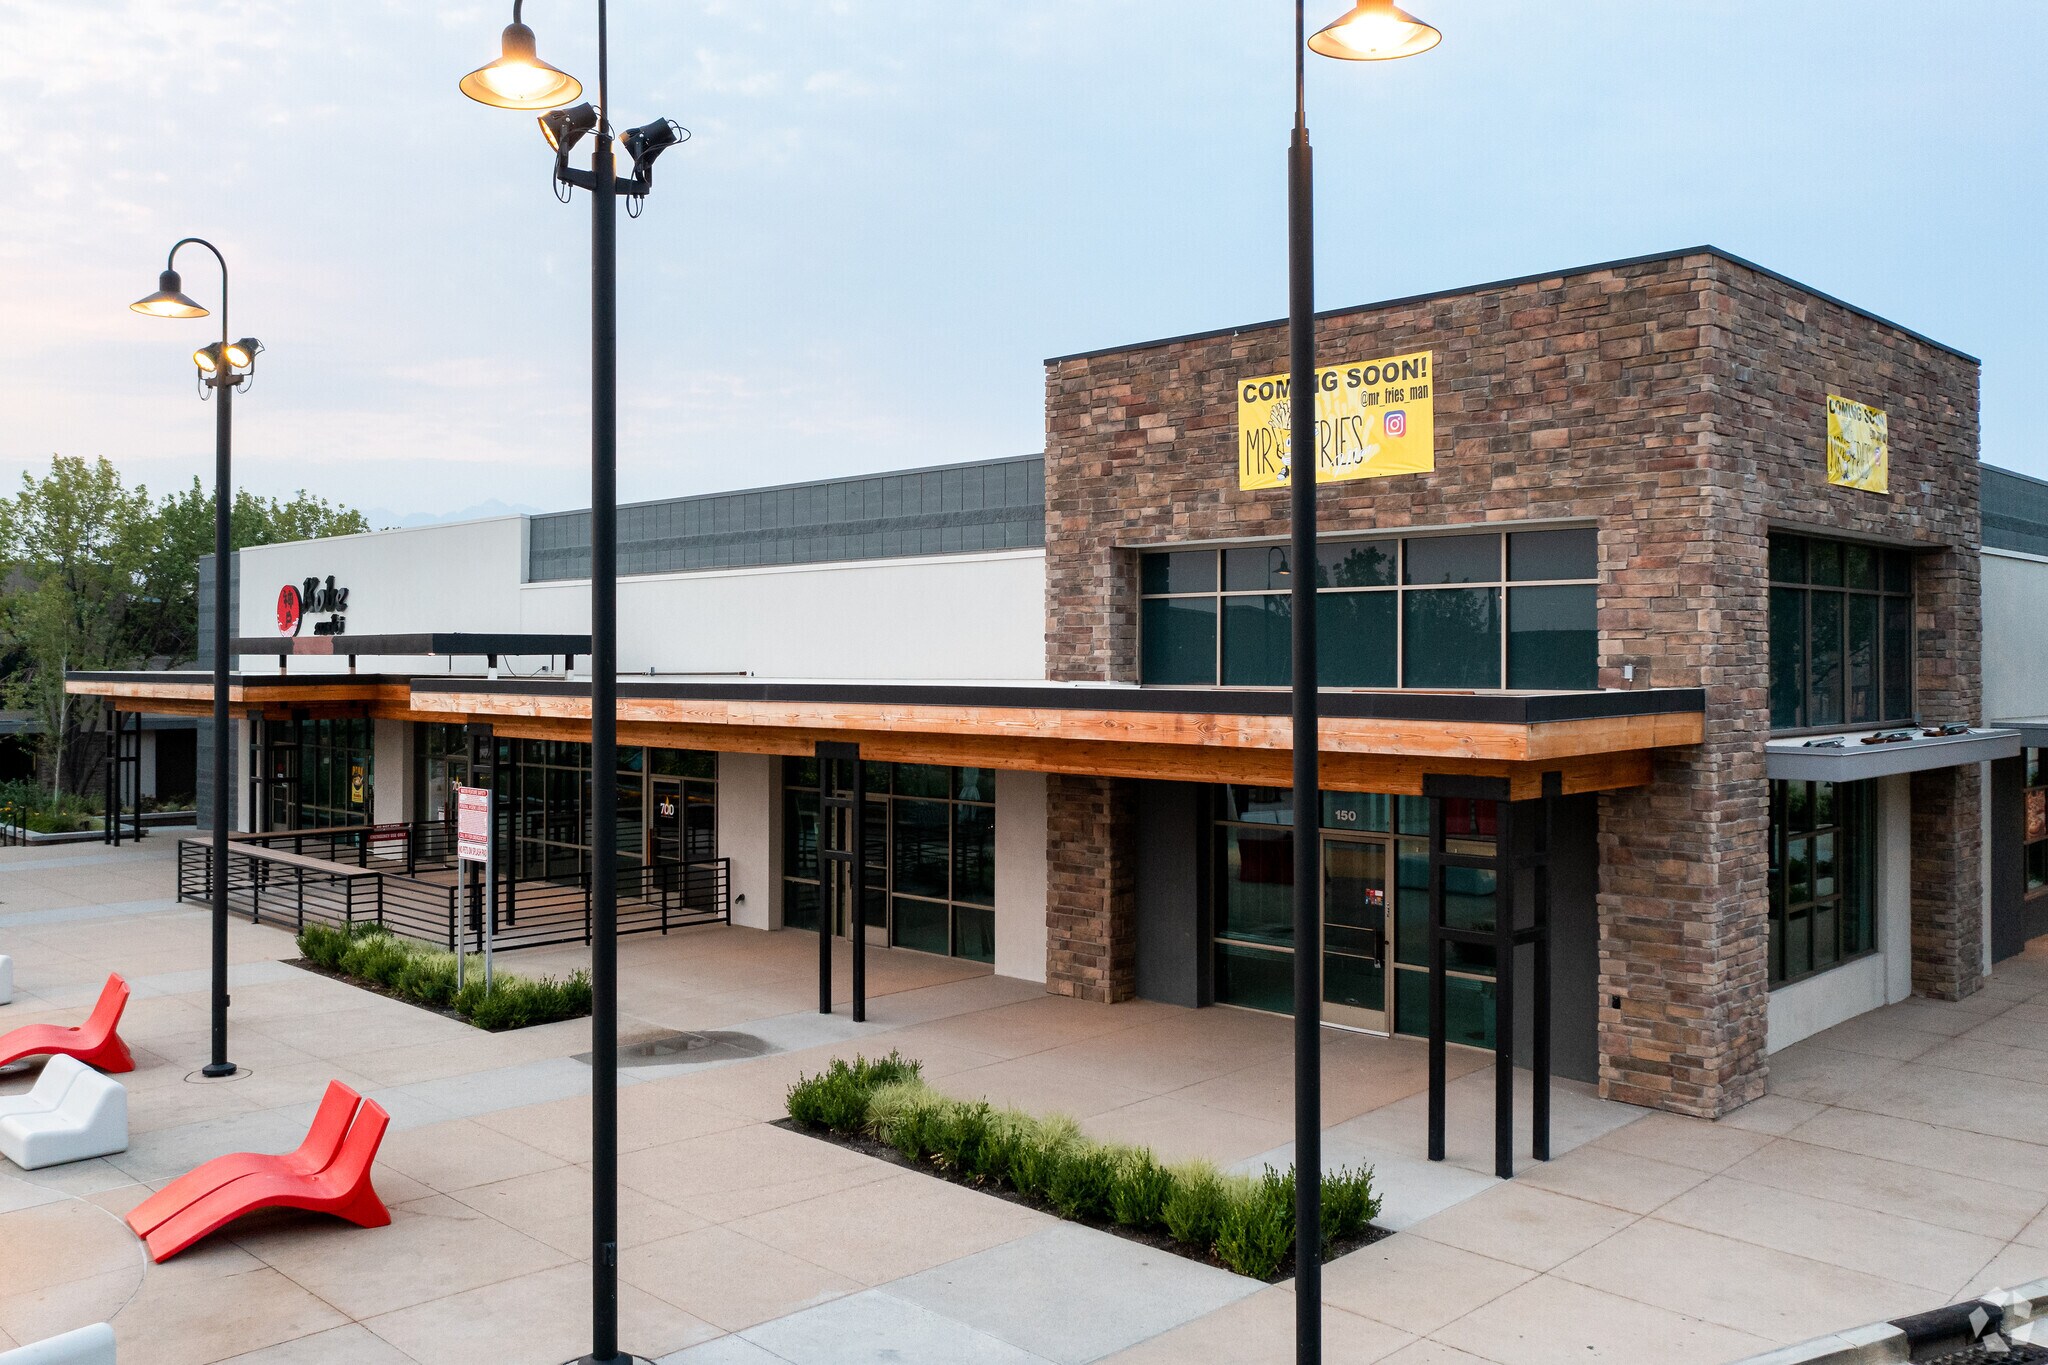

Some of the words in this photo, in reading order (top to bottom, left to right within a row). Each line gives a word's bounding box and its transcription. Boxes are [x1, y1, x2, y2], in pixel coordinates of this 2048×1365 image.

[1243, 371, 1338, 403] COMG
[1346, 357, 1427, 388] SOON!
[1246, 427, 1275, 476] MR
[1314, 415, 1364, 468] RIES
[302, 575, 349, 614] Kobe
[660, 803, 674, 815] 700
[1335, 810, 1356, 821] 150
